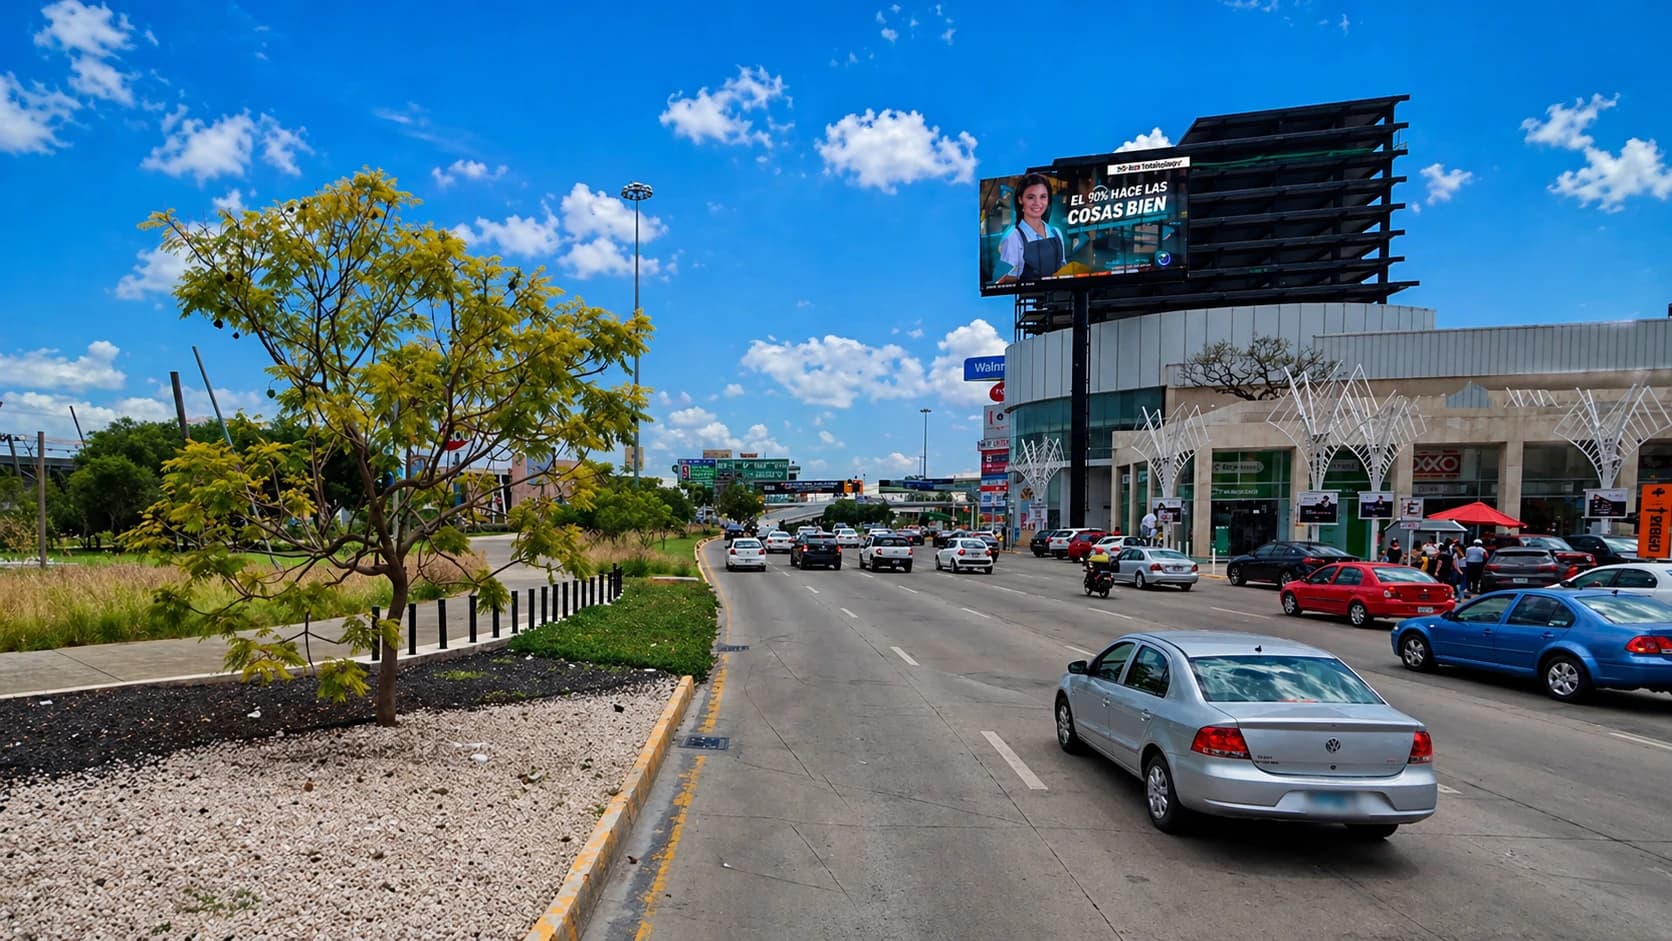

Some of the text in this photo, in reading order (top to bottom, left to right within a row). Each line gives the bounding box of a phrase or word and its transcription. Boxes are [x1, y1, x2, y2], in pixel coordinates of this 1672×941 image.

[1070, 181, 1168, 206] EL 90% HACE LAS
[1067, 196, 1167, 225] COSAS BIEN
